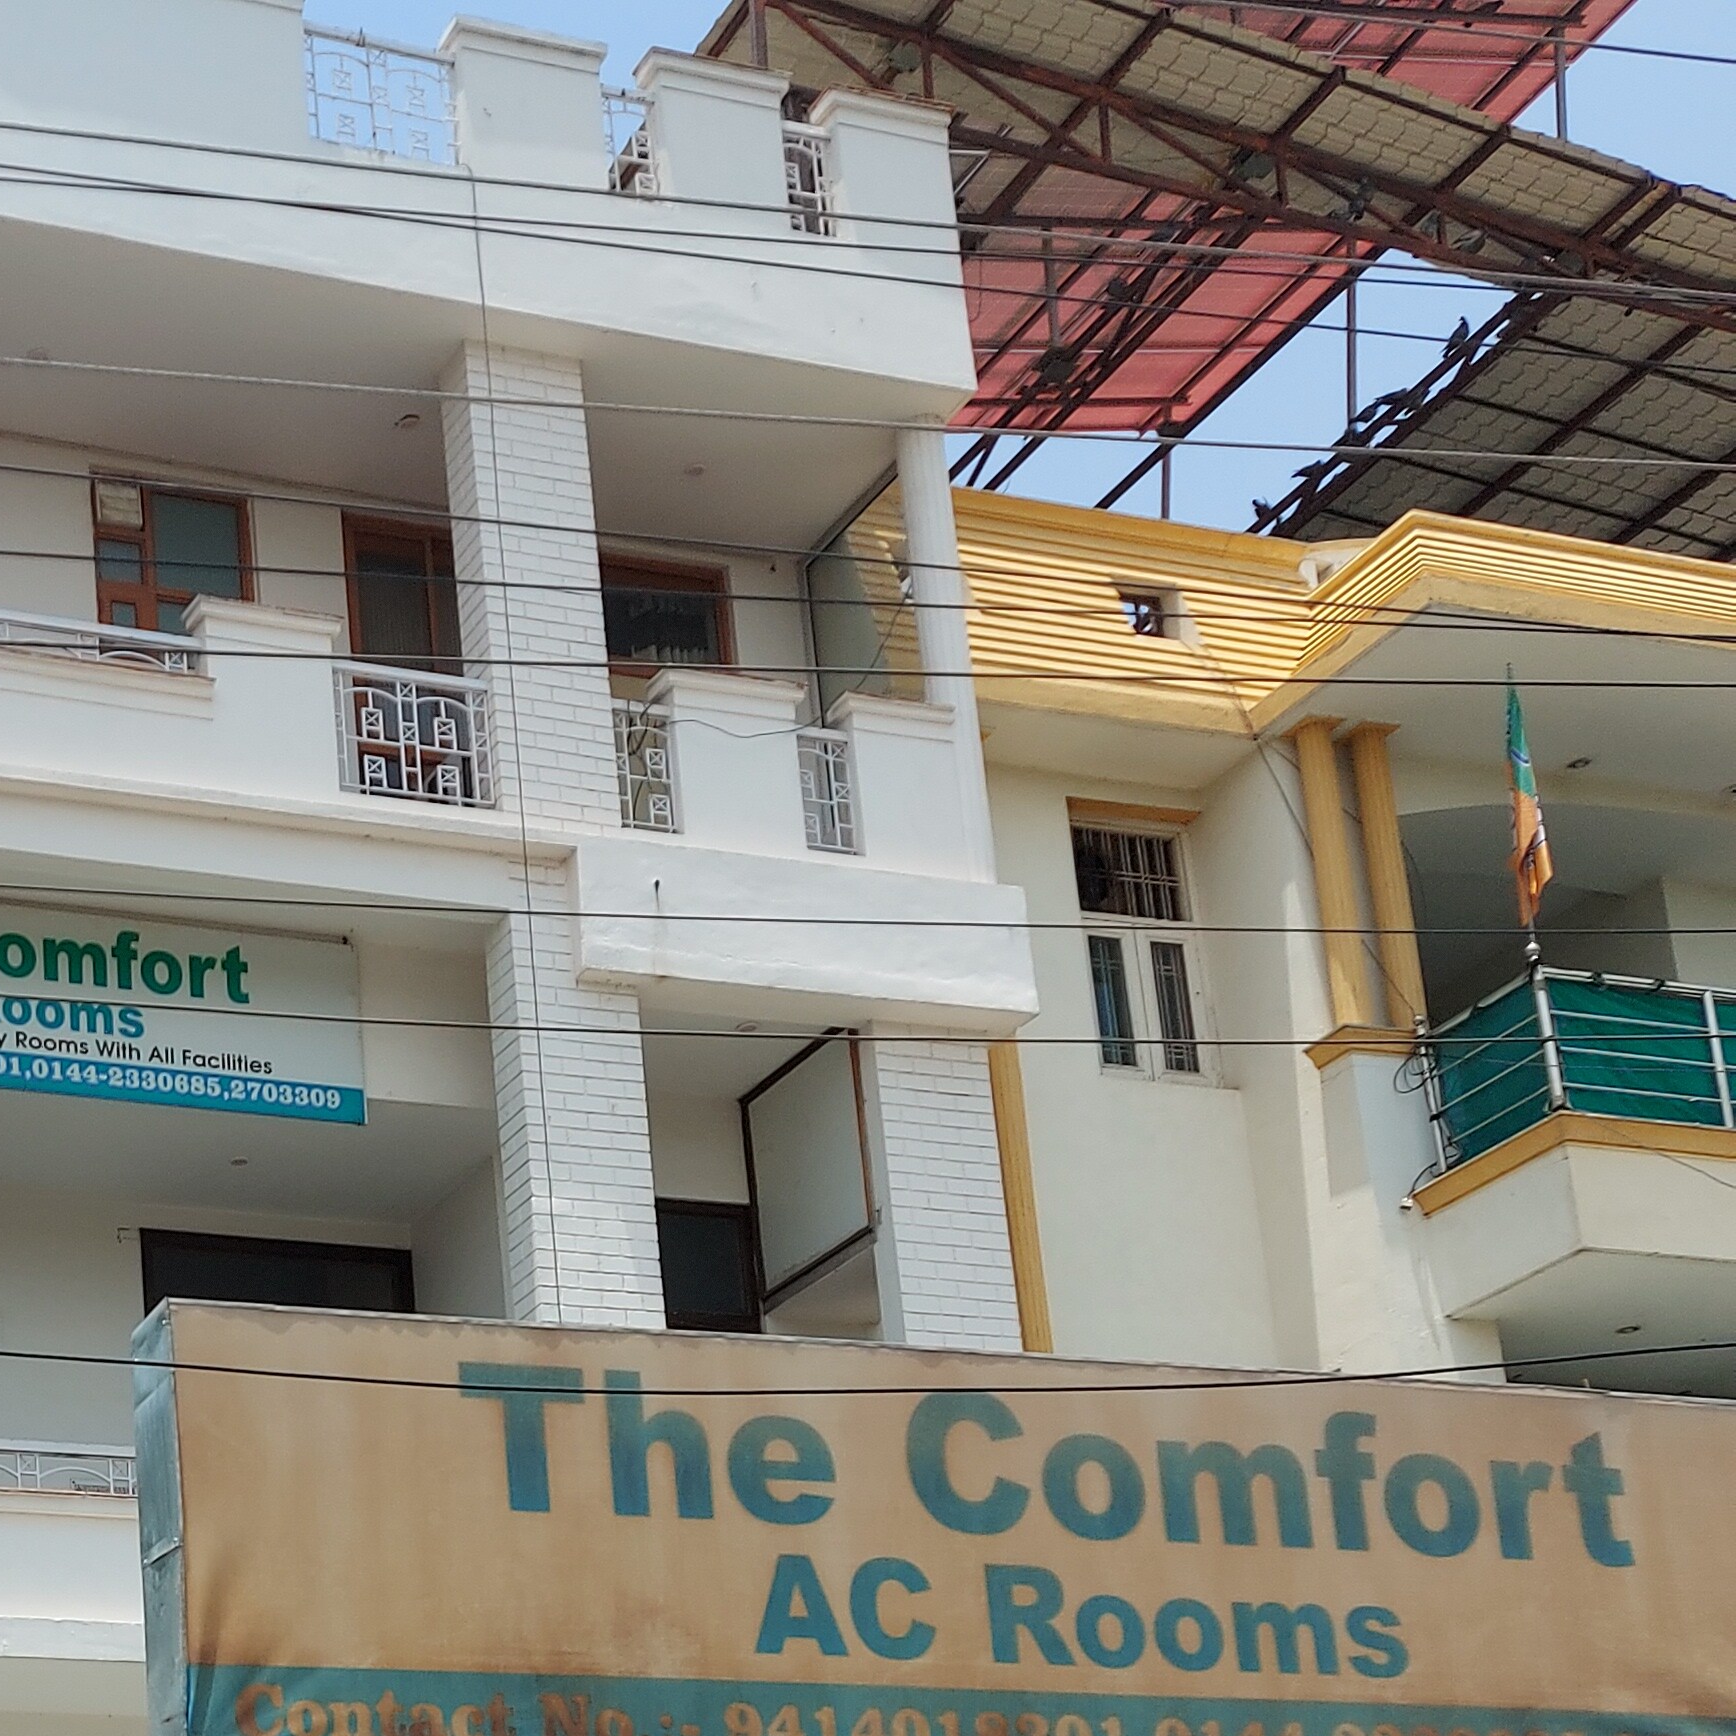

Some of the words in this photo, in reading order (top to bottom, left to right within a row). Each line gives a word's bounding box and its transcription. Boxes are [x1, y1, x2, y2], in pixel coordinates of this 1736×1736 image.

[15, 1031, 89, 1056] Rooms
[95, 1039, 141, 1062] With
[148, 1046, 175, 1065] All
[182, 1049, 273, 1075] Facilities
[458, 1360, 837, 1526] The
[906, 1391, 1637, 1569] Comfort
[754, 1553, 938, 1661] AC
[983, 1563, 1409, 1680] Rooms
